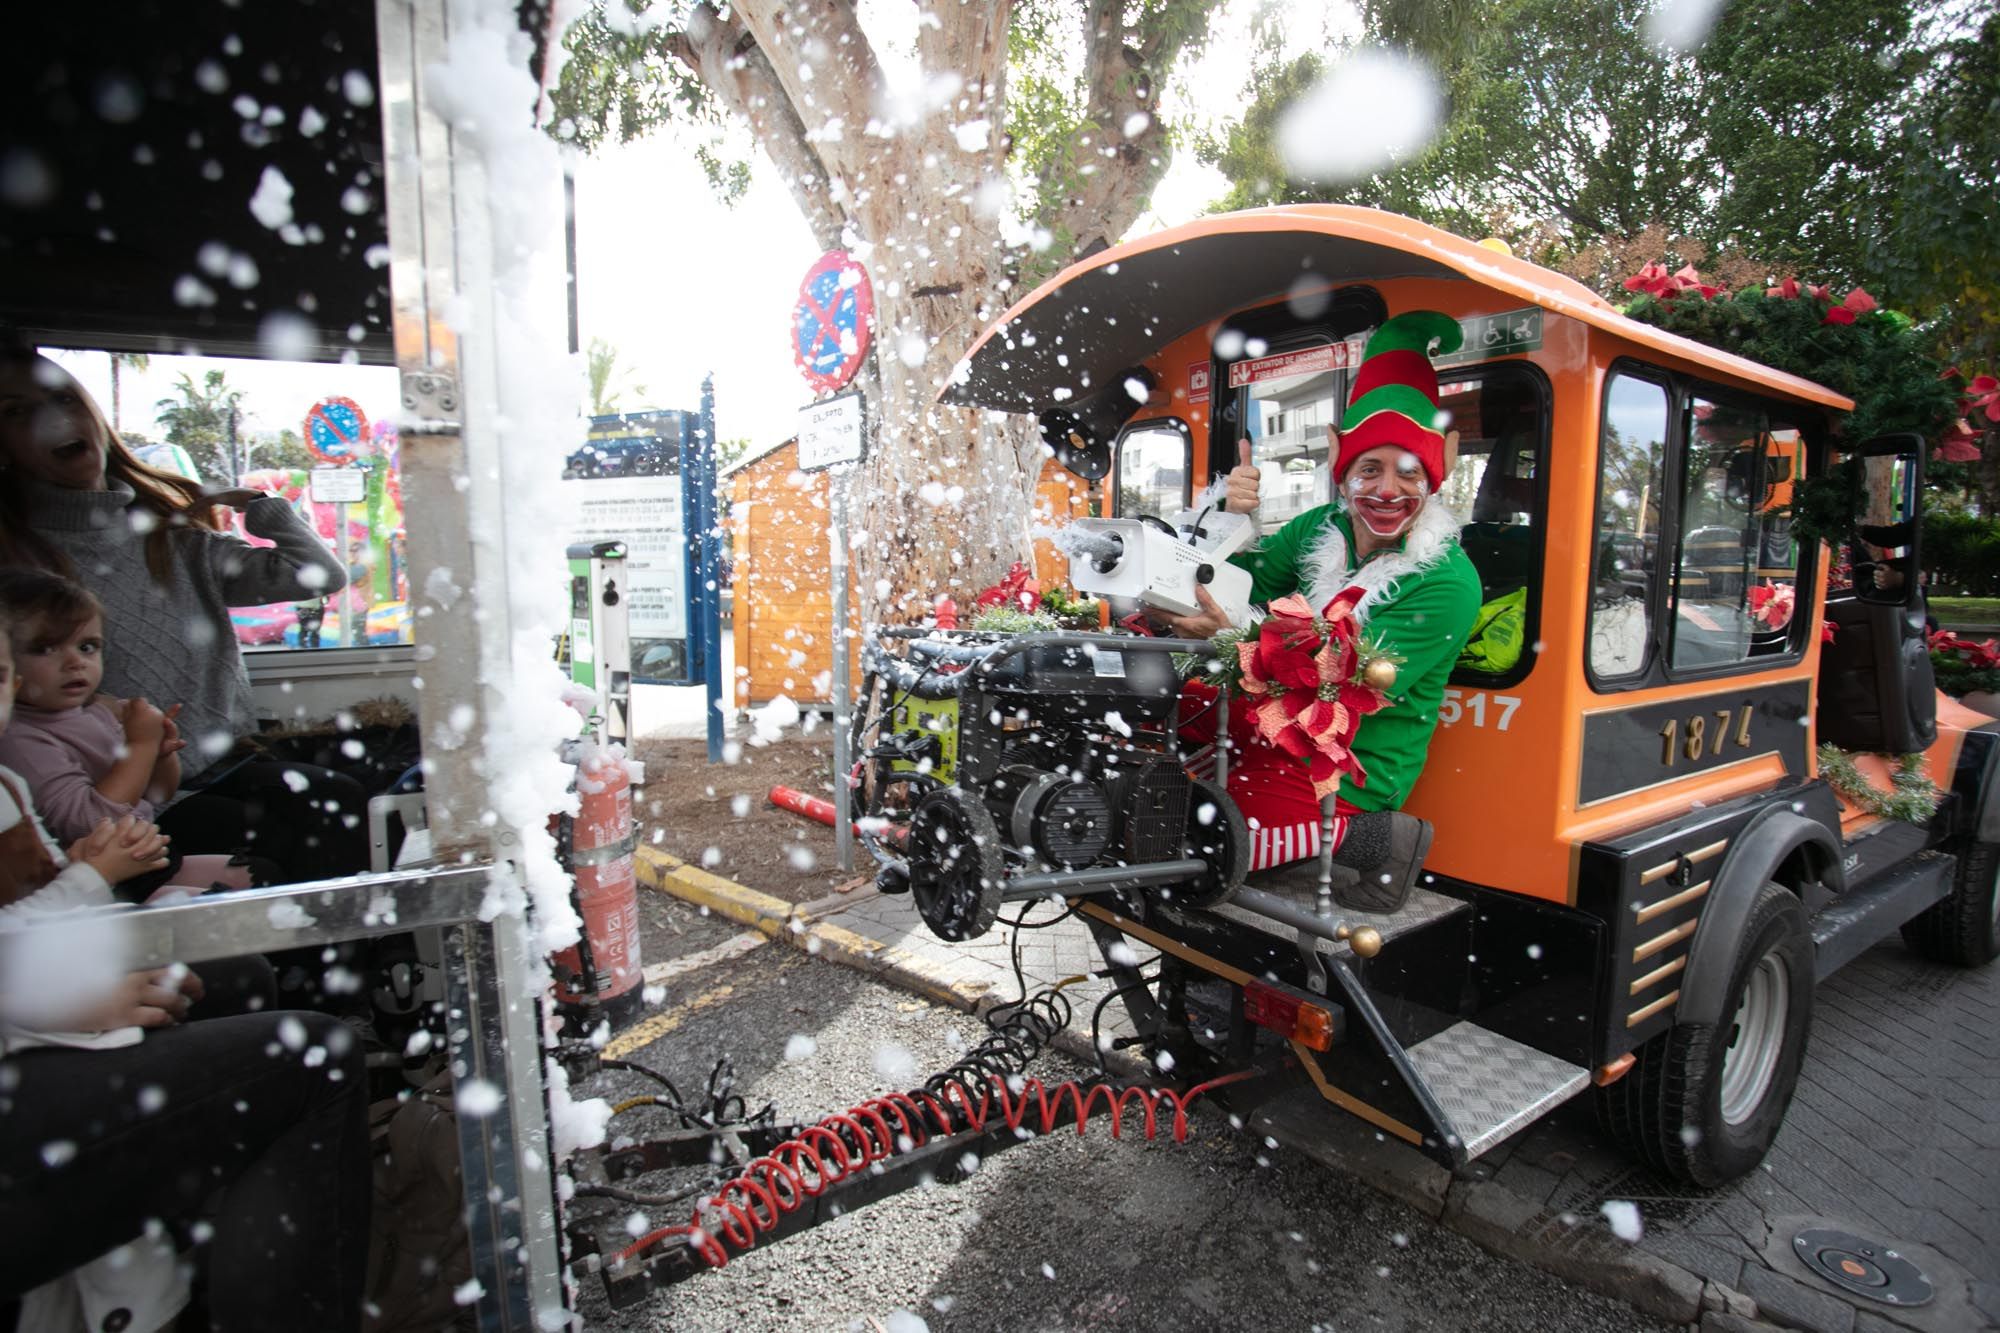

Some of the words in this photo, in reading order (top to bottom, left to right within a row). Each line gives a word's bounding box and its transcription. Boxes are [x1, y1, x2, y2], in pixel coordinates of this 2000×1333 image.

[1285, 355, 1295, 366] DE
[1439, 689, 1522, 731] 517
[1662, 705, 1753, 767] 1874
